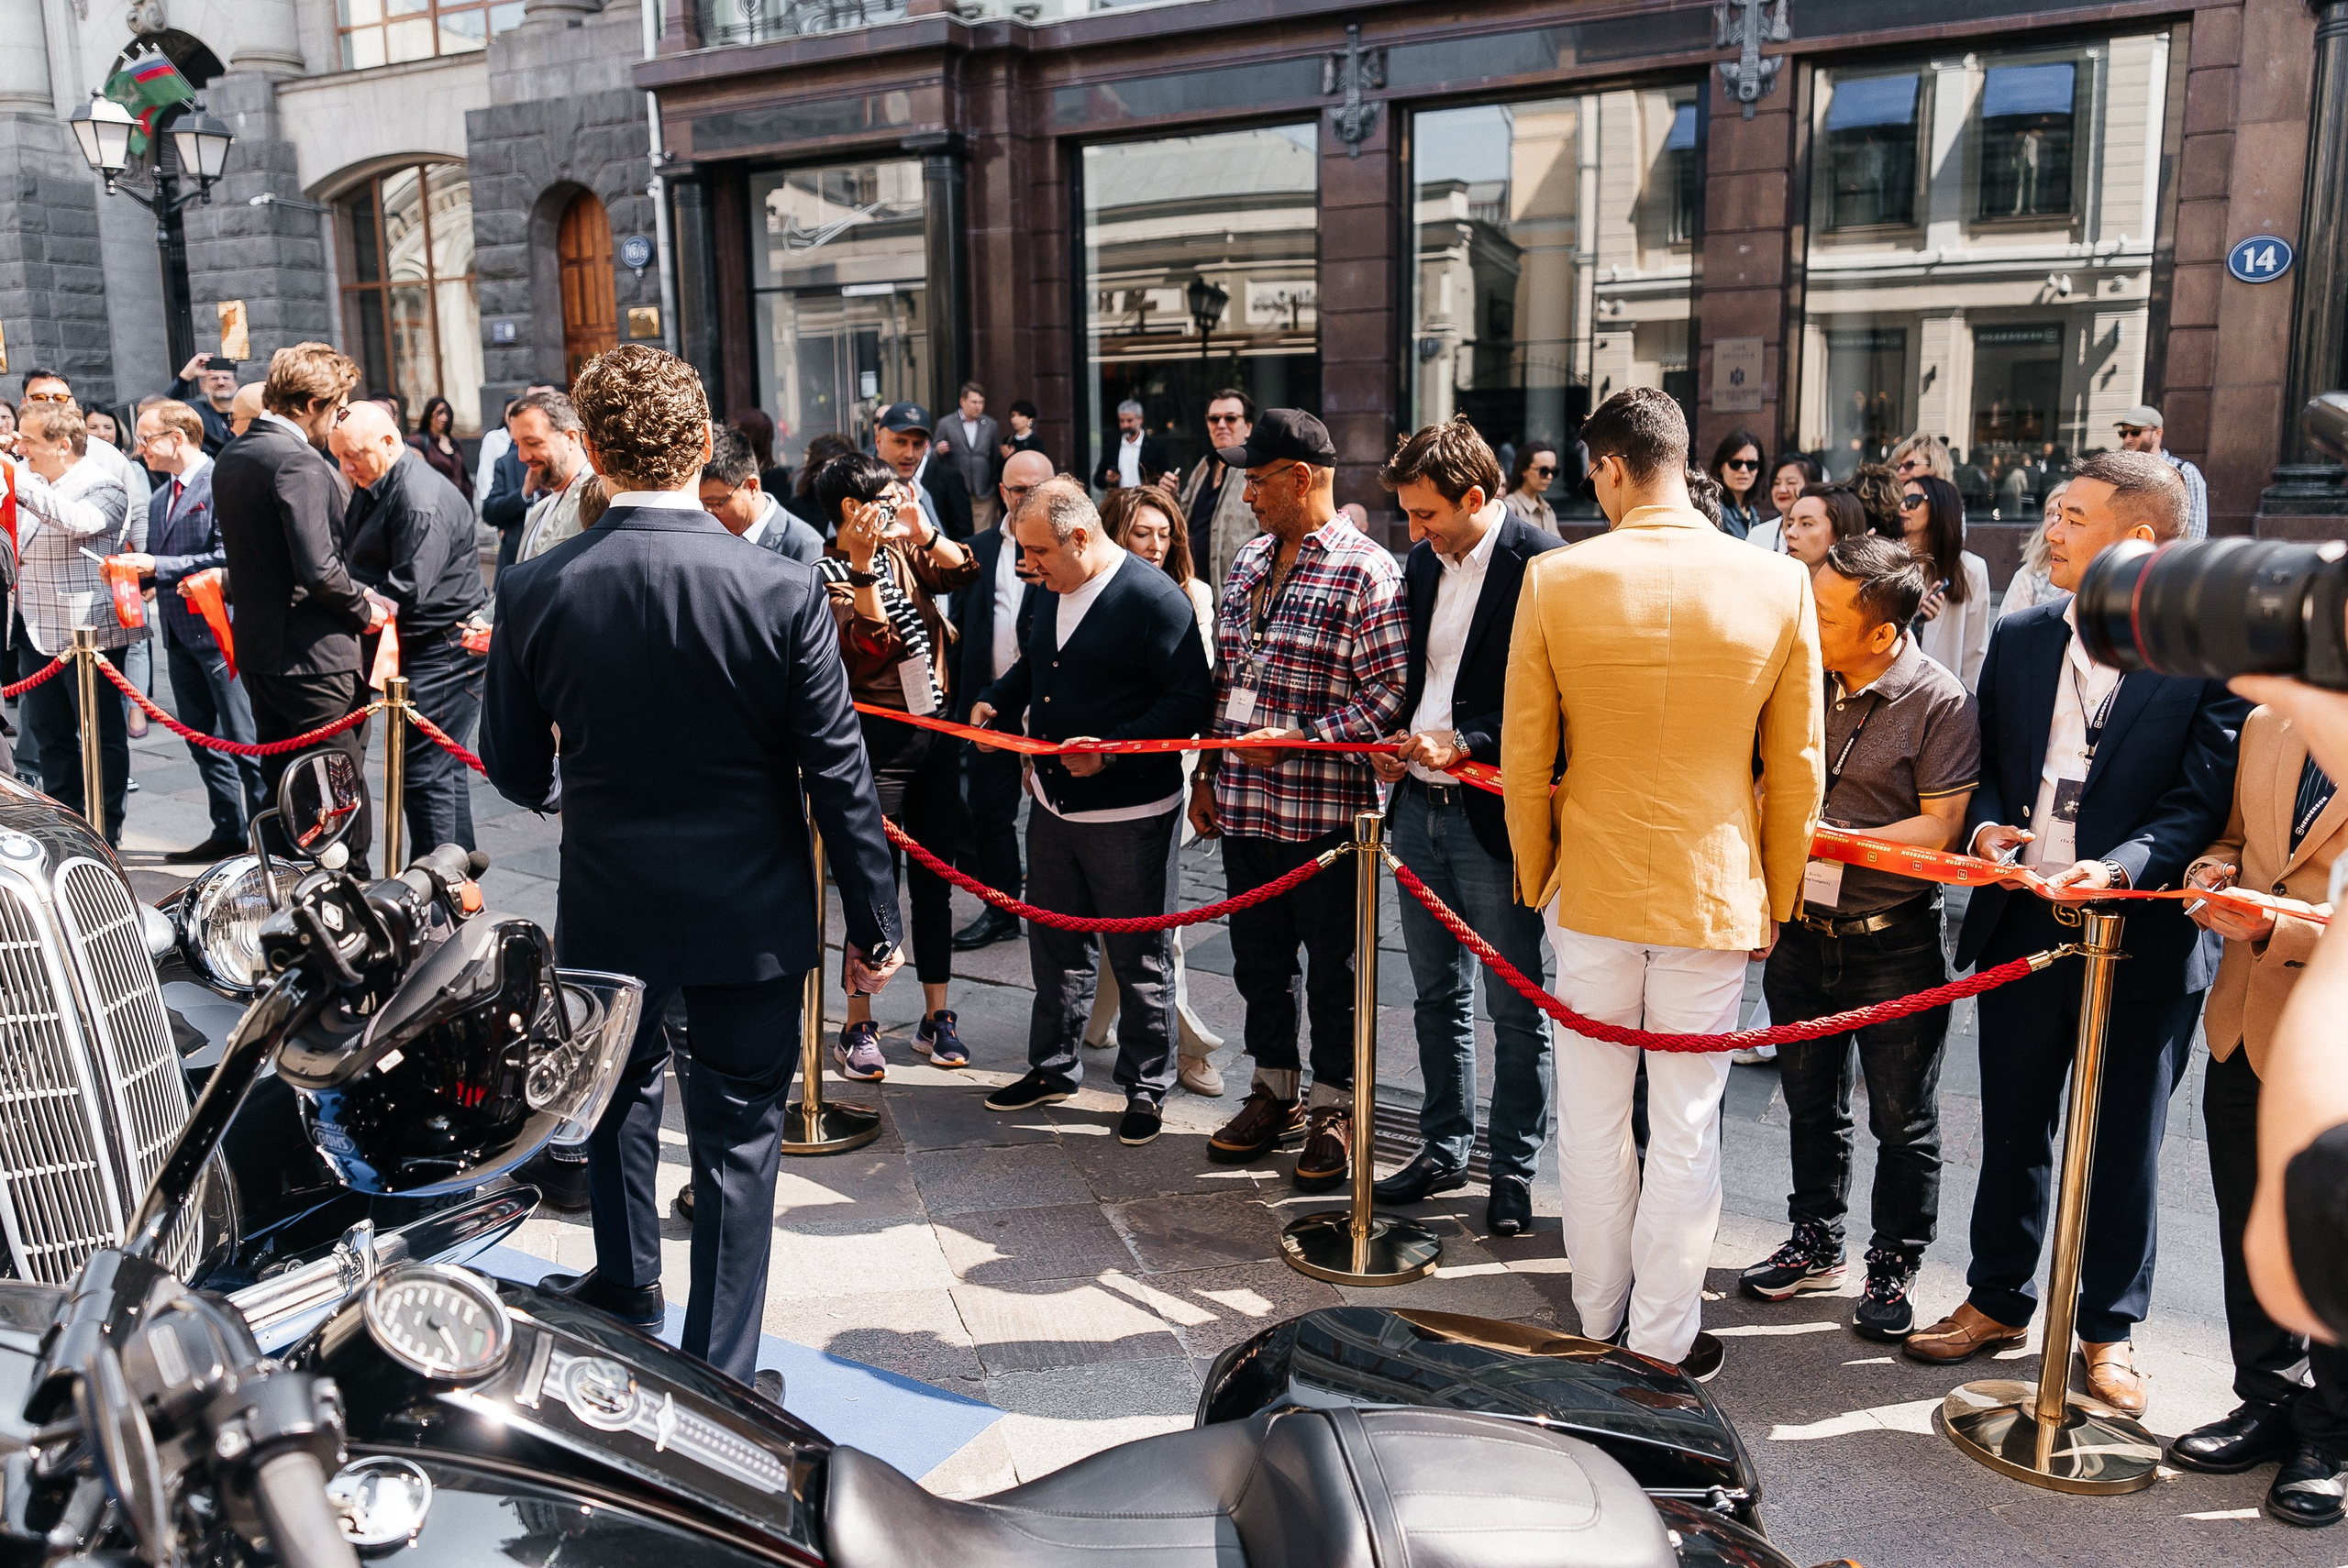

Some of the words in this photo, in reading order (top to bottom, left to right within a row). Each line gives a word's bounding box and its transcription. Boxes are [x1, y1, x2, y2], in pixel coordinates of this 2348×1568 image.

[2243, 245, 2277, 272] 14
[2299, 796, 2328, 829] HENDERSON
[1816, 833, 1850, 843] HENDERSON
[1856, 841, 1891, 852] HENDERSON
[1901, 849, 1937, 861] HENDERSON
[1945, 858, 1983, 869] HENDERSON
